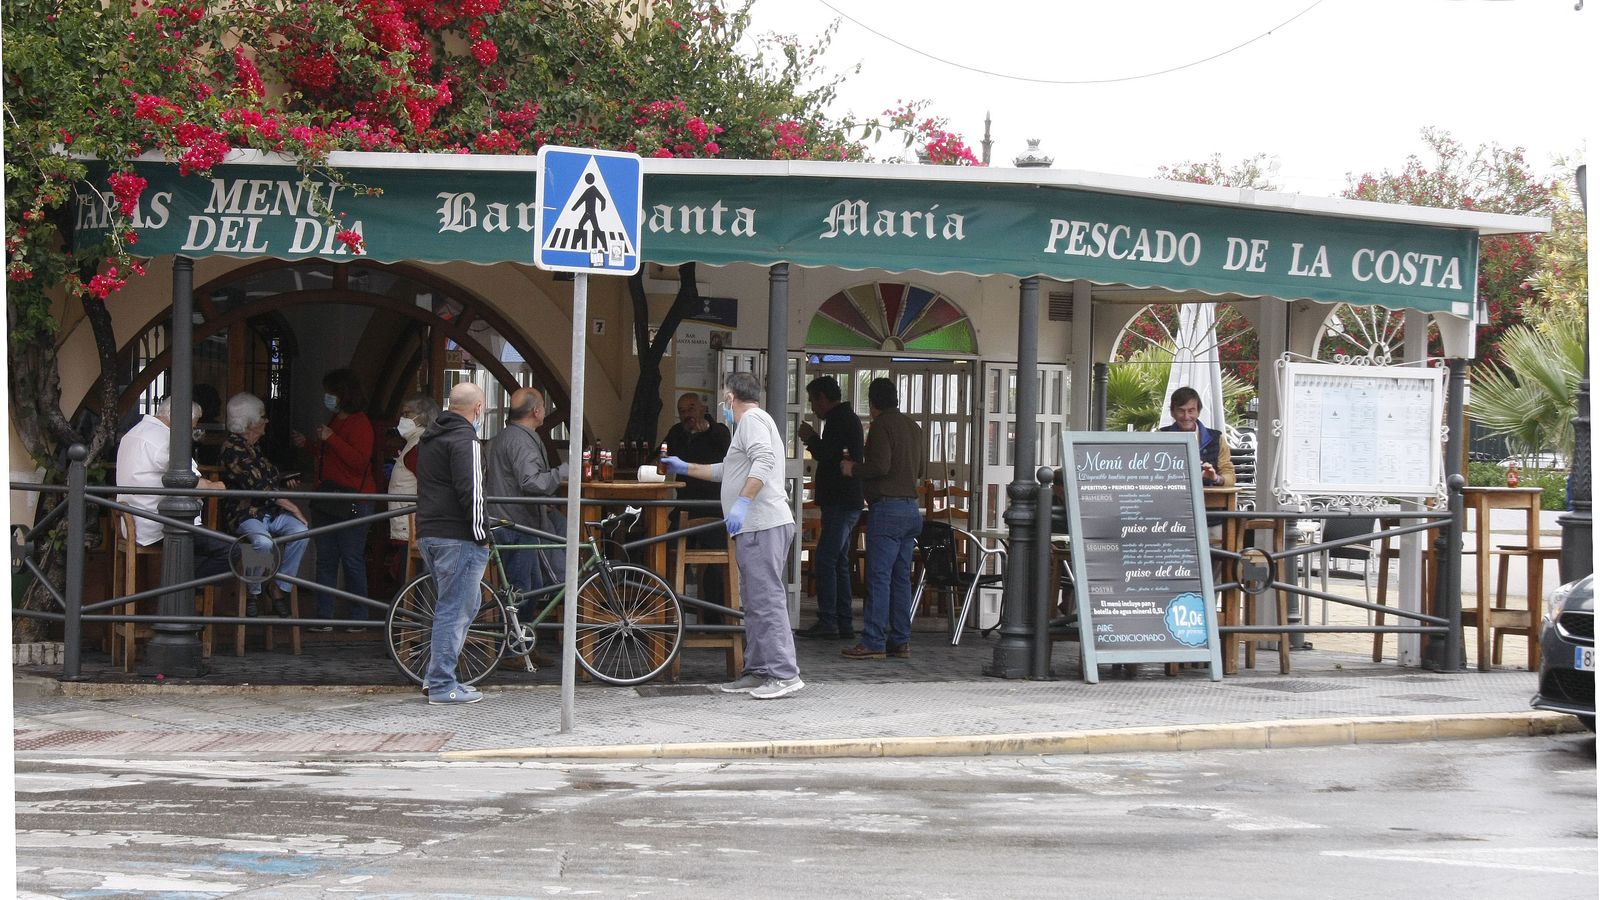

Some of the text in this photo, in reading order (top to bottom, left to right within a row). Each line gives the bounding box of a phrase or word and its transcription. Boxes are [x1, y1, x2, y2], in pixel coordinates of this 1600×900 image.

[436, 191, 966, 241] Bar anta María
[181, 215, 269, 253] DEL
[1043, 217, 1463, 290] PESCADO DE LA COSTA
[1076, 451, 1185, 472] Menú del Día
[1121, 523, 1147, 538] guiso
[1151, 521, 1167, 533] del
[1086, 544, 1119, 552] SEGUNDOS
[1125, 568, 1151, 582] guiso
[1155, 565, 1172, 577] del
[1121, 600, 1141, 608] incluye
[1096, 624, 1114, 632] AIRE
[1097, 633, 1167, 643] ACONDICIONADO
